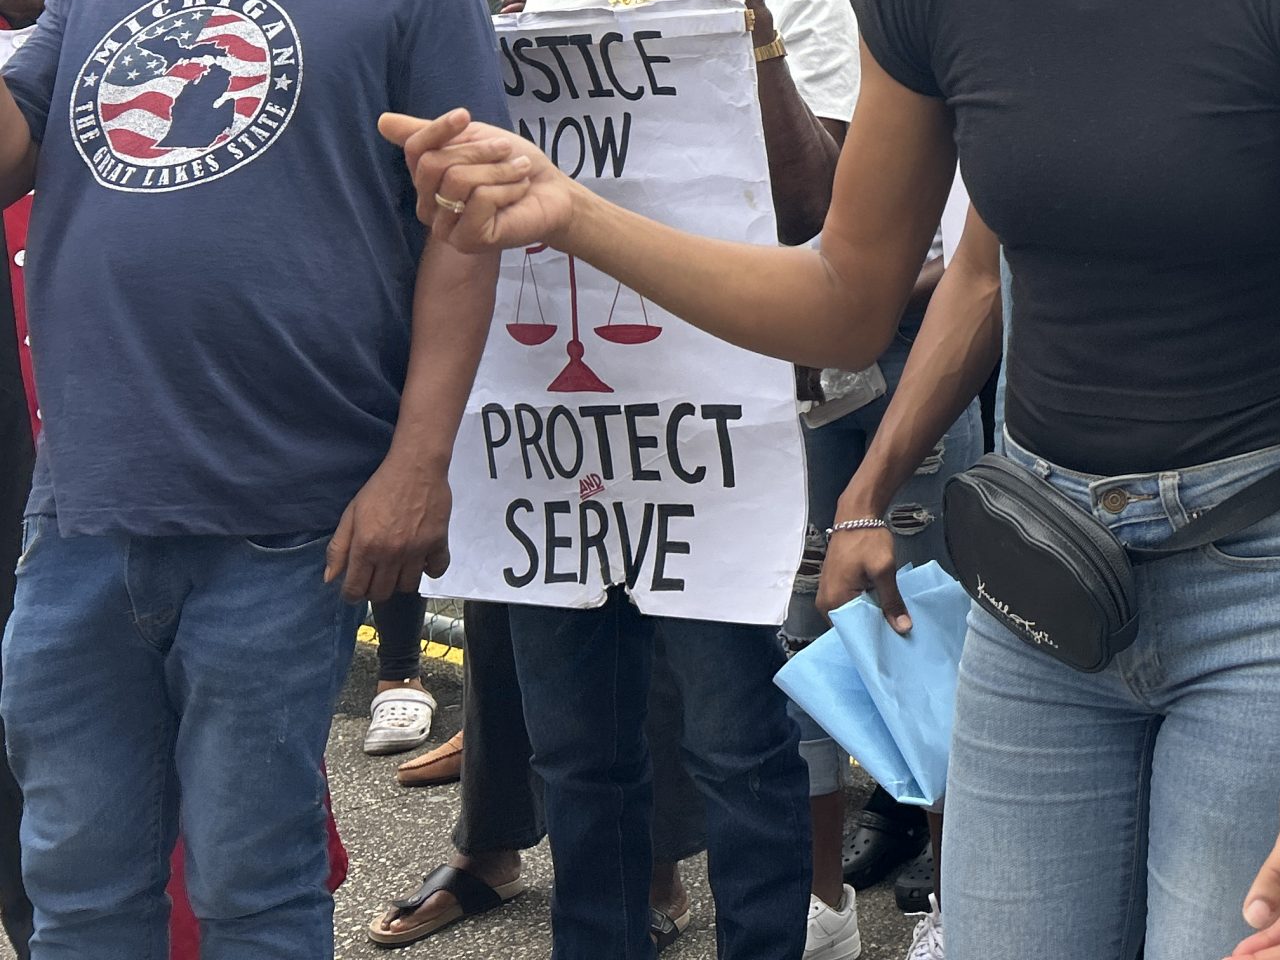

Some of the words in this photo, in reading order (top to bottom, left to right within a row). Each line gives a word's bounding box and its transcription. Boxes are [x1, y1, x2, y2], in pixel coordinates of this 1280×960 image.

[500, 30, 677, 103] USTICE
[75, 100, 100, 143] THE
[92, 146, 137, 185] GREAT
[142, 153, 220, 186] LAKES
[227, 101, 287, 160] STATE
[518, 112, 632, 180] NOW
[481, 402, 743, 488] PROTECT
[578, 472, 605, 497] AND
[502, 498, 695, 592] SERVE
